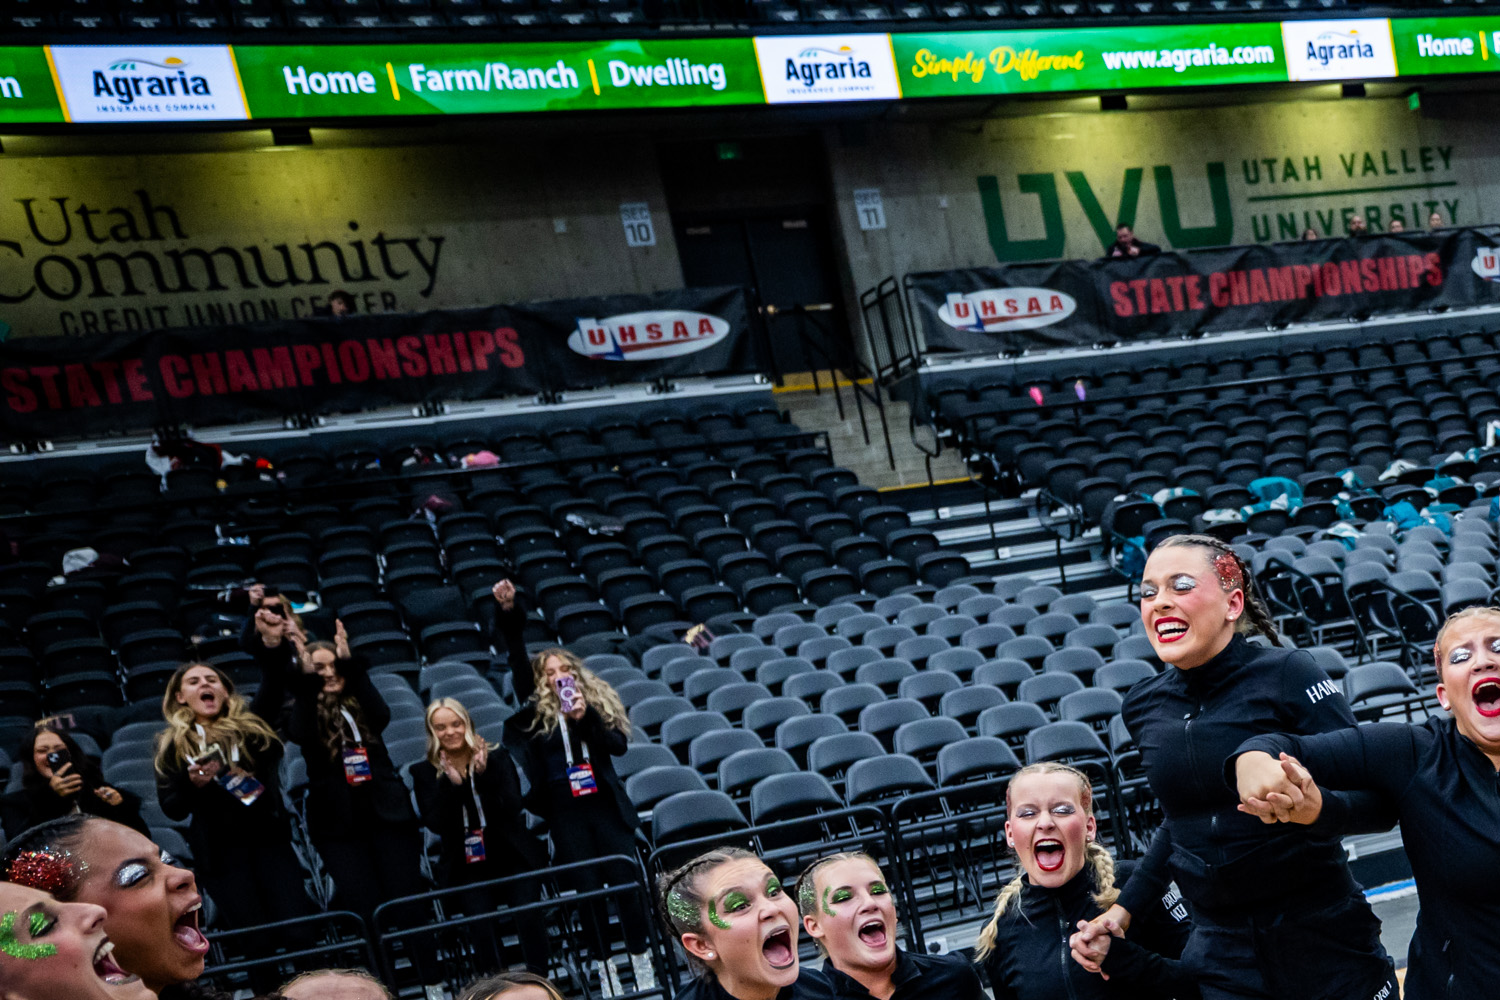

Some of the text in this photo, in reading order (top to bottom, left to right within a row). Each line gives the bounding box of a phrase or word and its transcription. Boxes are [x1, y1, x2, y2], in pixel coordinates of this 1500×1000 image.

[1102, 43, 1275, 72] www.agraria.com
[1307, 40, 1374, 66] Agraria
[1417, 33, 1474, 57] Home
[283, 66, 377, 95] Home
[408, 60, 579, 92] Farm/Ranch
[608, 58, 727, 90] Dwelling
[786, 56, 872, 87] Agraria
[912, 46, 1085, 83] Simply Different
[93, 70, 212, 104] Agraria
[1242, 146, 1455, 185] UTAH VALLEY
[14, 190, 189, 247] Utah
[977, 161, 1234, 262] UVU
[1251, 200, 1460, 243] UNIVERSITY
[625, 223, 650, 242] 10
[1110, 252, 1443, 317] STATE CHAMPIONSHIPS
[60, 305, 169, 337] CREDIT
[955, 294, 1064, 319] UHSAA
[587, 317, 715, 346] UHSAA
[2, 327, 525, 413] STATE CHAMPIONSHIPS
